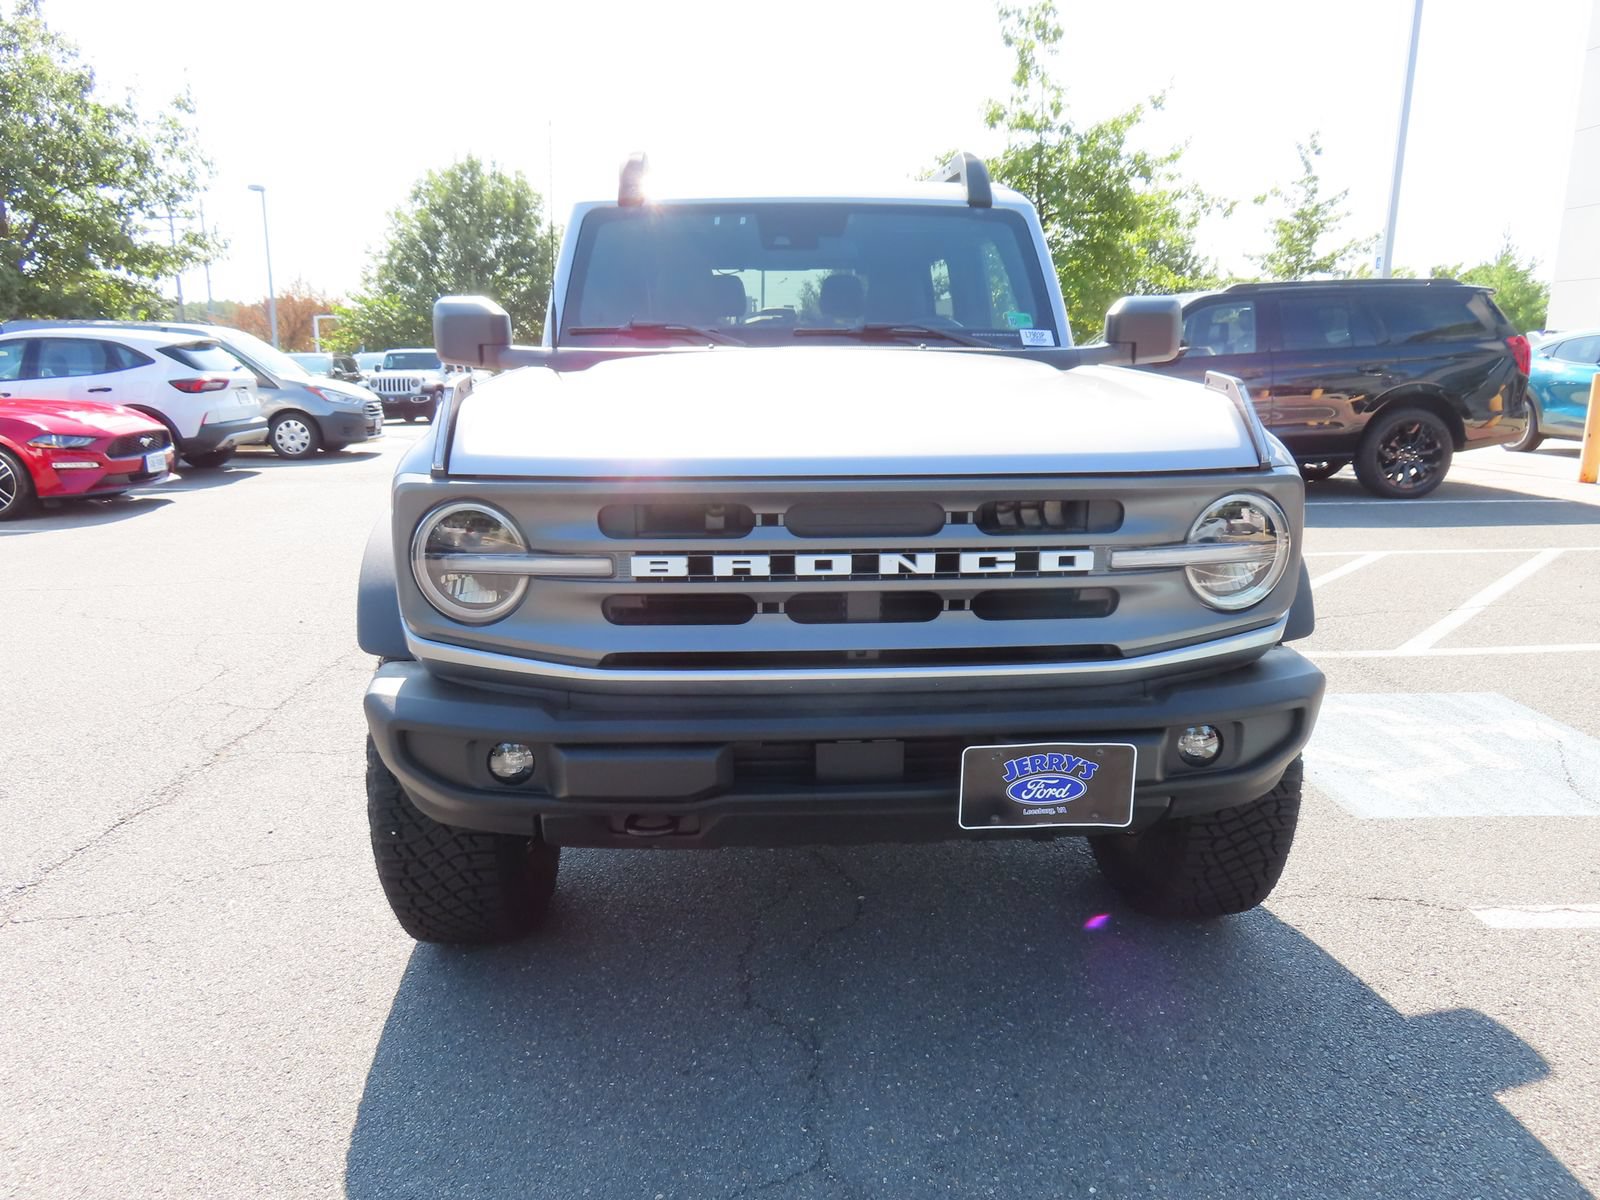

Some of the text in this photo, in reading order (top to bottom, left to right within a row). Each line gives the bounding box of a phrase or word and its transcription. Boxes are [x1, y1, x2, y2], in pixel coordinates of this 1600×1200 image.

[630, 549, 1095, 577] BRONCO
[1002, 753, 1099, 782] JERRY'S
[1021, 779, 1071, 800] Ford
